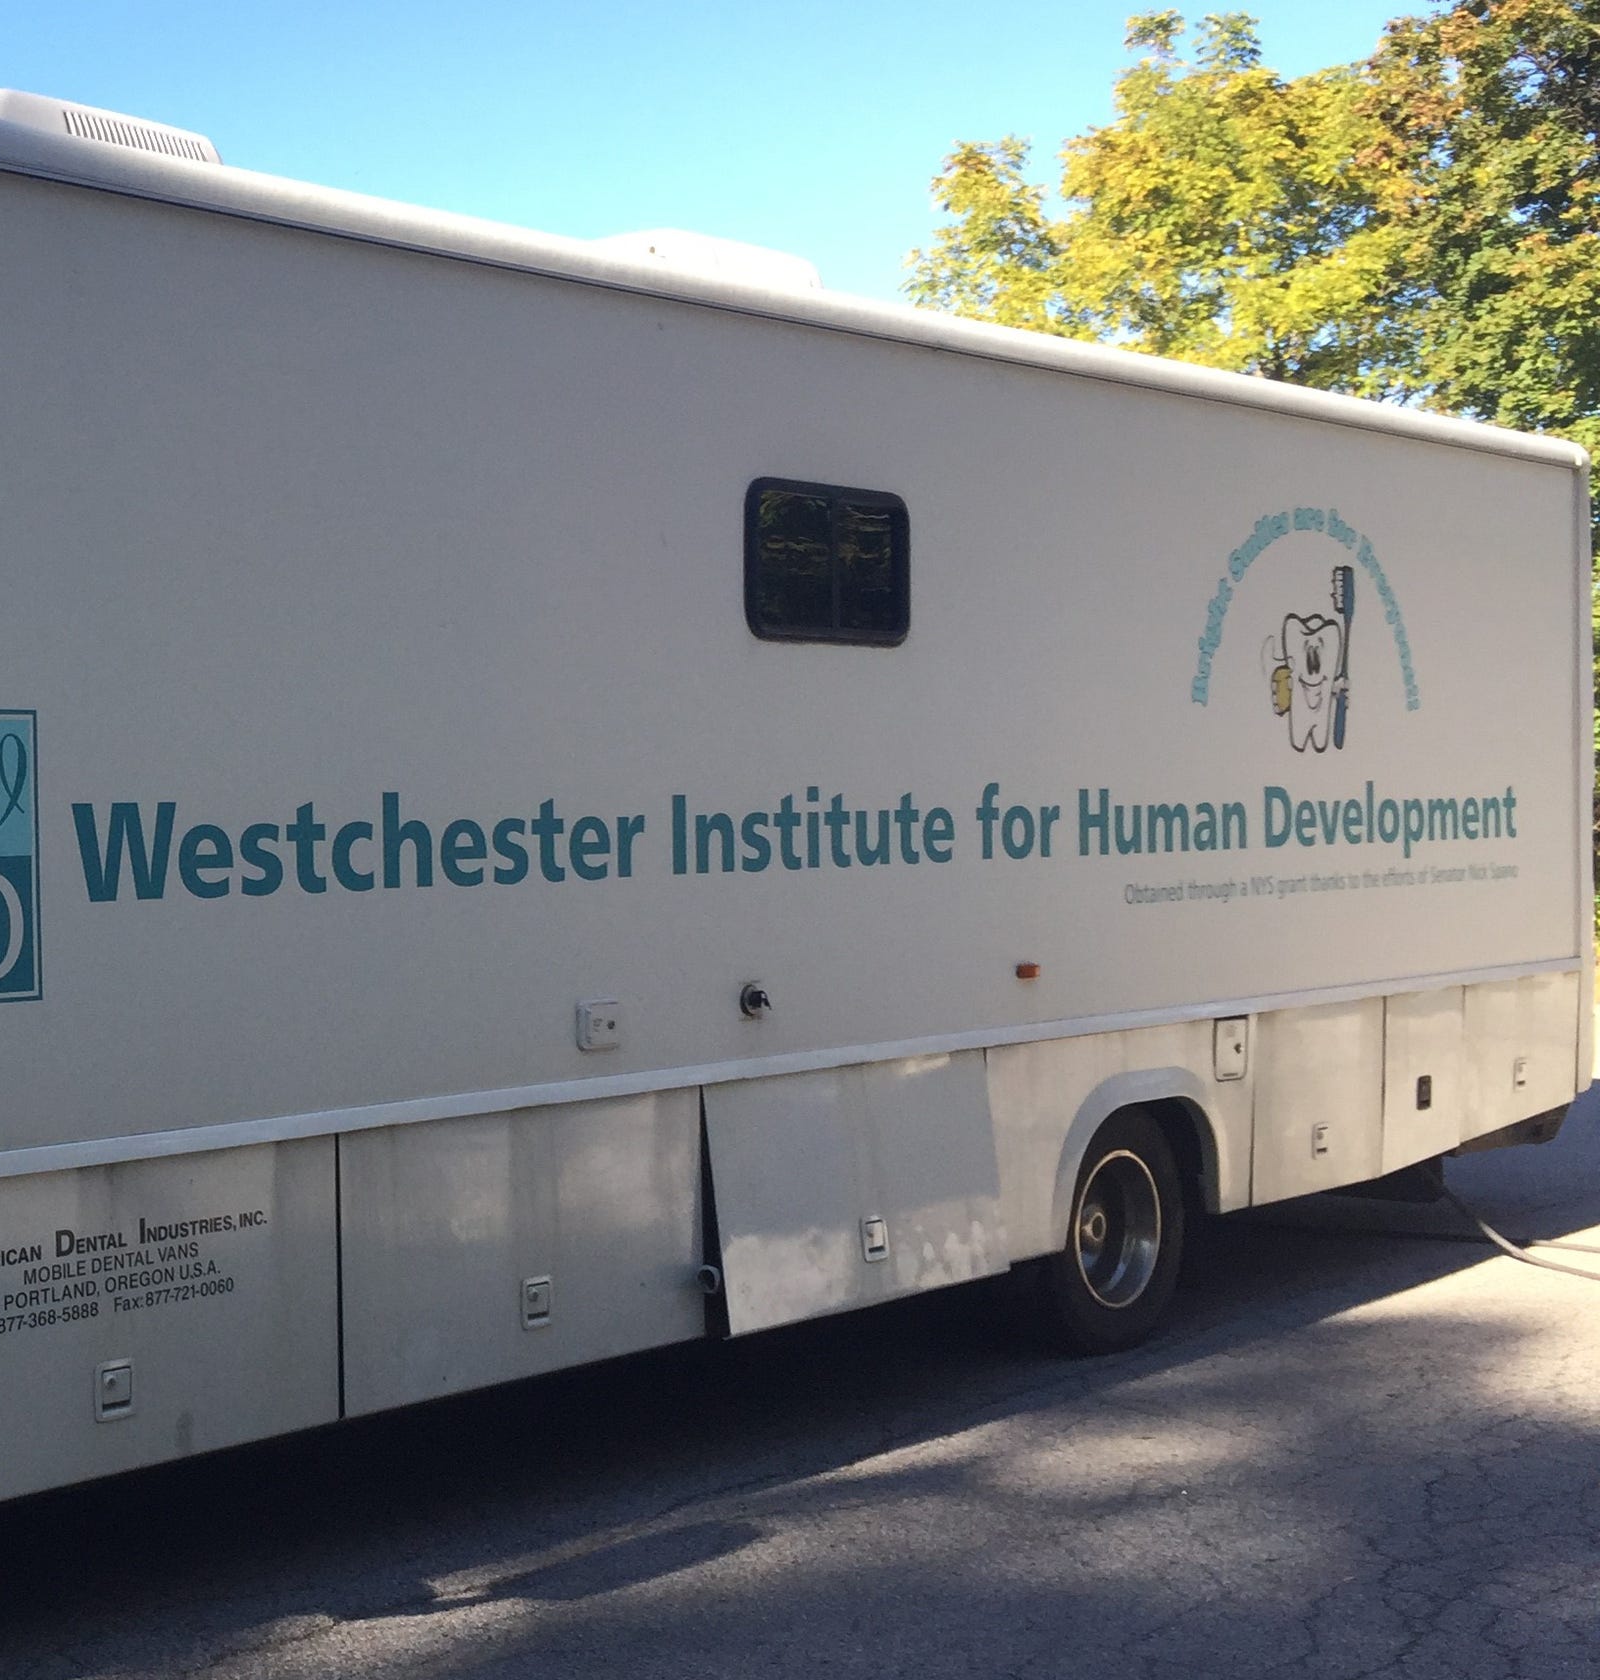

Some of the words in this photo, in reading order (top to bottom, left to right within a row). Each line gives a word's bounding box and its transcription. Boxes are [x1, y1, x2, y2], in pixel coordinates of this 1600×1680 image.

[71, 792, 645, 903] Westchester
[672, 786, 954, 875] Institute
[976, 783, 1060, 860] for
[1078, 788, 1247, 856] Human
[1264, 781, 1517, 858] Development
[1125, 880, 1184, 904] Obtained
[1188, 878, 1237, 903] through
[1240, 882, 1248, 896] a
[1251, 875, 1273, 895] NYS
[1278, 875, 1307, 899] grant
[1310, 871, 1345, 892] thanks
[1347, 871, 1360, 889] to
[1362, 869, 1379, 888] the
[55, 1229, 128, 1258] DENTAL
[239, 1210, 268, 1228] INC.
[4, 1281, 100, 1311] PORTLAND,
[105, 1267, 175, 1293] OREGON
[179, 1260, 221, 1281] U.S.A.
[23, 1260, 86, 1285] MOBILE
[92, 1249, 154, 1274] DENTAL
[157, 1241, 199, 1262] VANS
